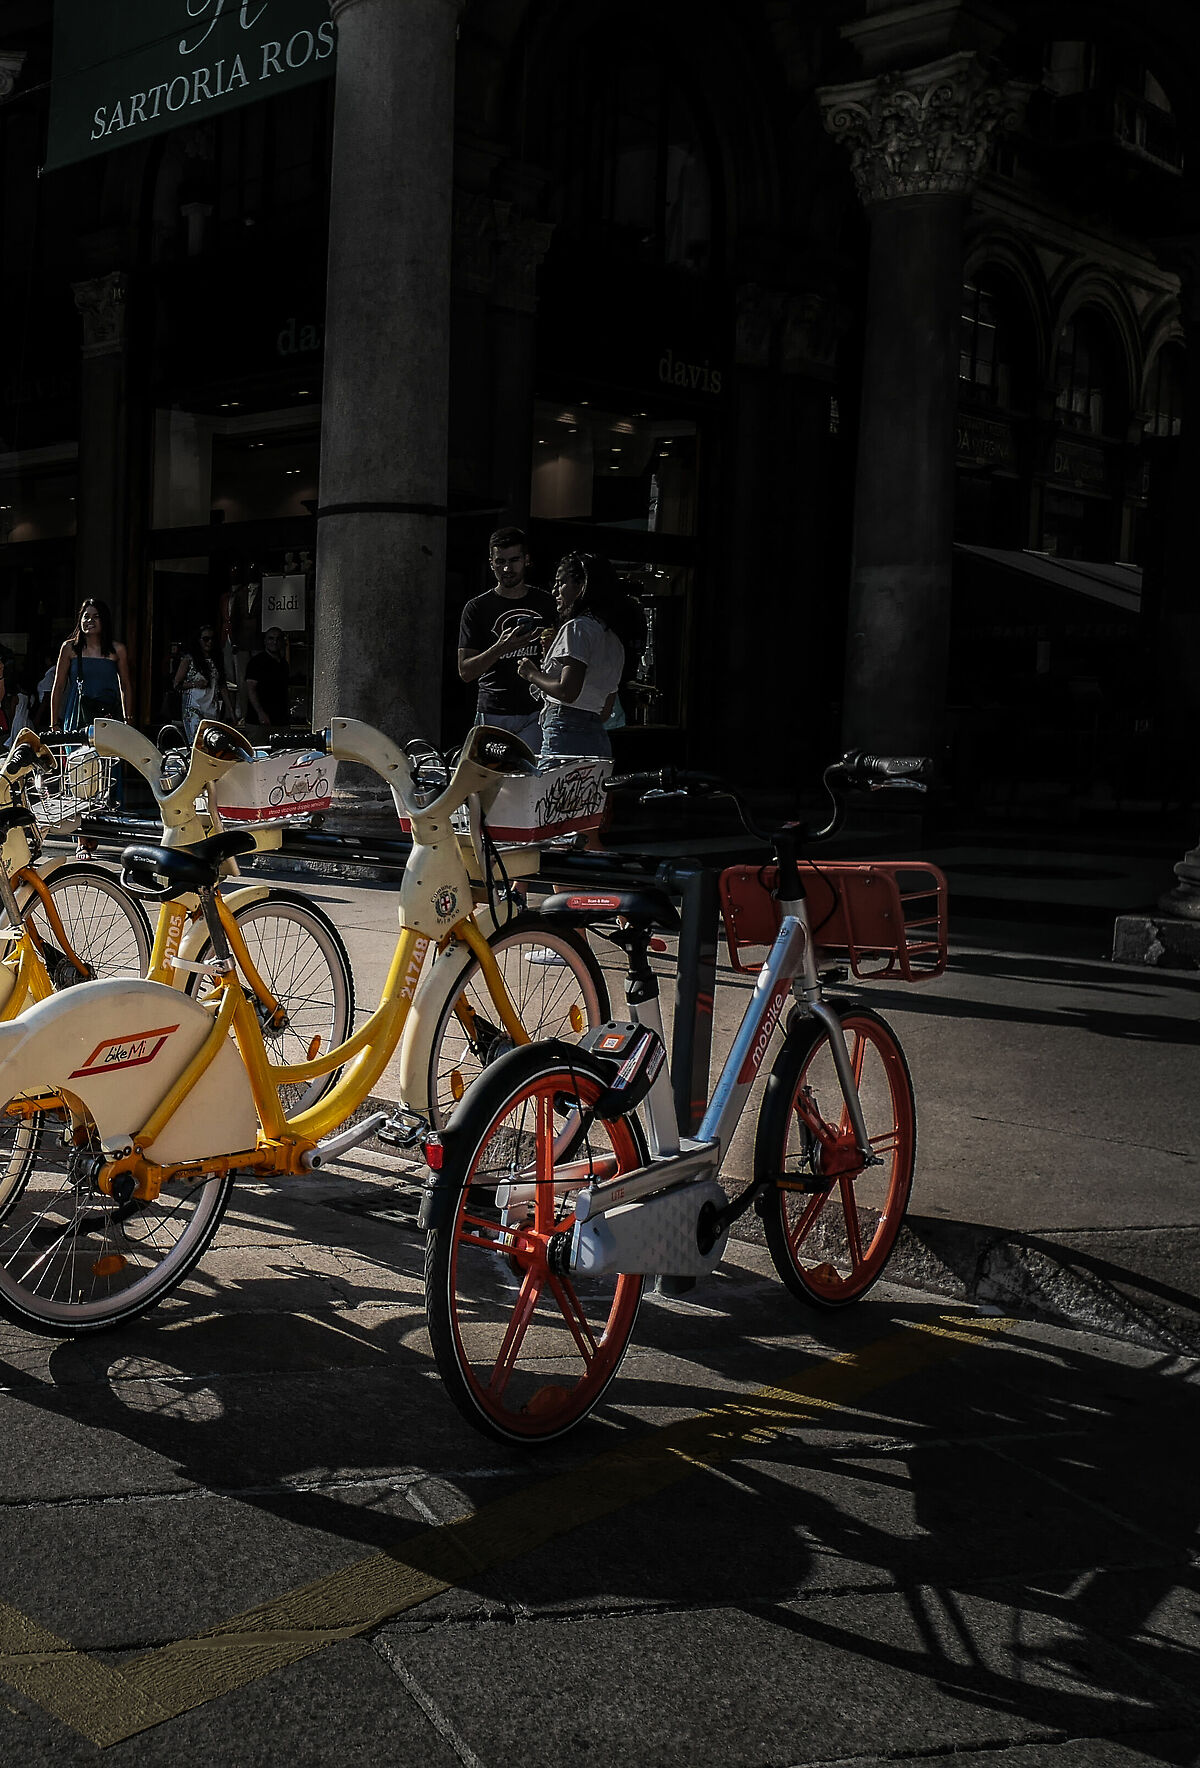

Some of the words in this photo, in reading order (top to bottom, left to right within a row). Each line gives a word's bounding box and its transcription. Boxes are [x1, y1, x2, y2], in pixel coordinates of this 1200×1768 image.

[90, 53, 250, 141] SARTORIA
[658, 347, 722, 394] davis
[267, 595, 299, 611] Saldi
[162, 915, 182, 972] 20705
[400, 937, 429, 1000] 21748
[104, 1040, 147, 1063] bikeMi
[752, 993, 783, 1068] mobike
[611, 1187, 625, 1201] LITE
